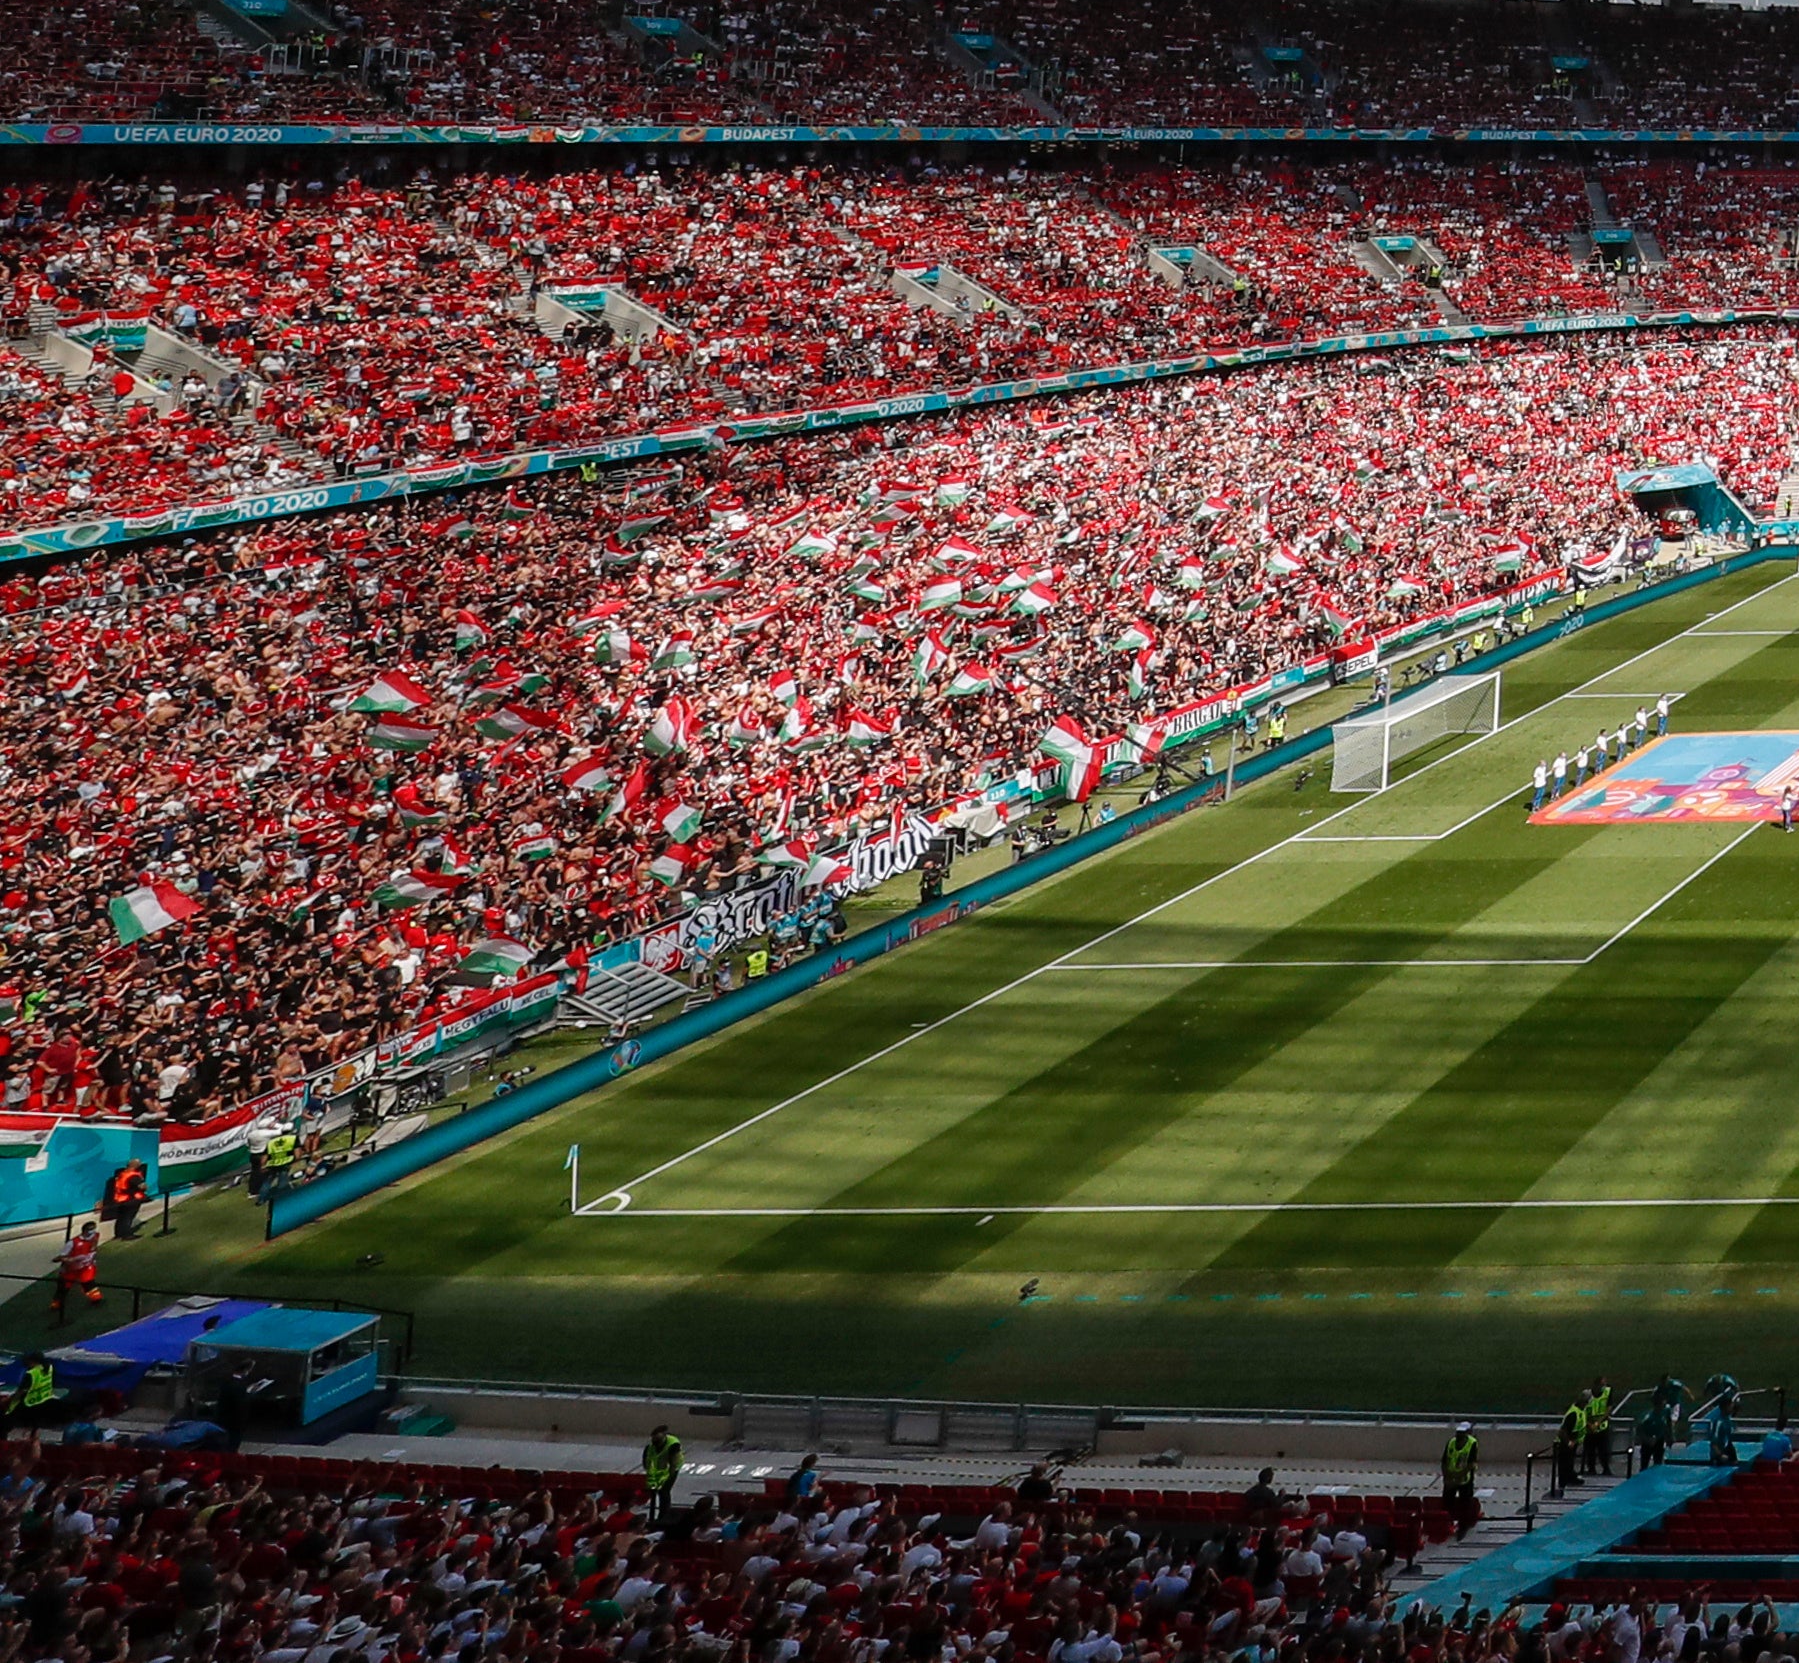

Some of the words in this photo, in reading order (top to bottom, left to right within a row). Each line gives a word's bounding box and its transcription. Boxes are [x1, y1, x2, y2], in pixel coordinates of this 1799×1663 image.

[114, 127, 168, 142] UEFA
[174, 127, 229, 142] EURO
[231, 127, 282, 142] 2020
[722, 128, 796, 141] BUDAPEST
[1133, 130, 1165, 139] EURO
[1165, 130, 1193, 139] 2020
[1481, 131, 1537, 140] BUDAPEST
[1536, 320, 1566, 331] UEFA
[1566, 319, 1597, 330] EURO
[1597, 317, 1626, 328] 2020
[890, 399, 925, 414] 2020
[270, 490, 330, 515] 2020
